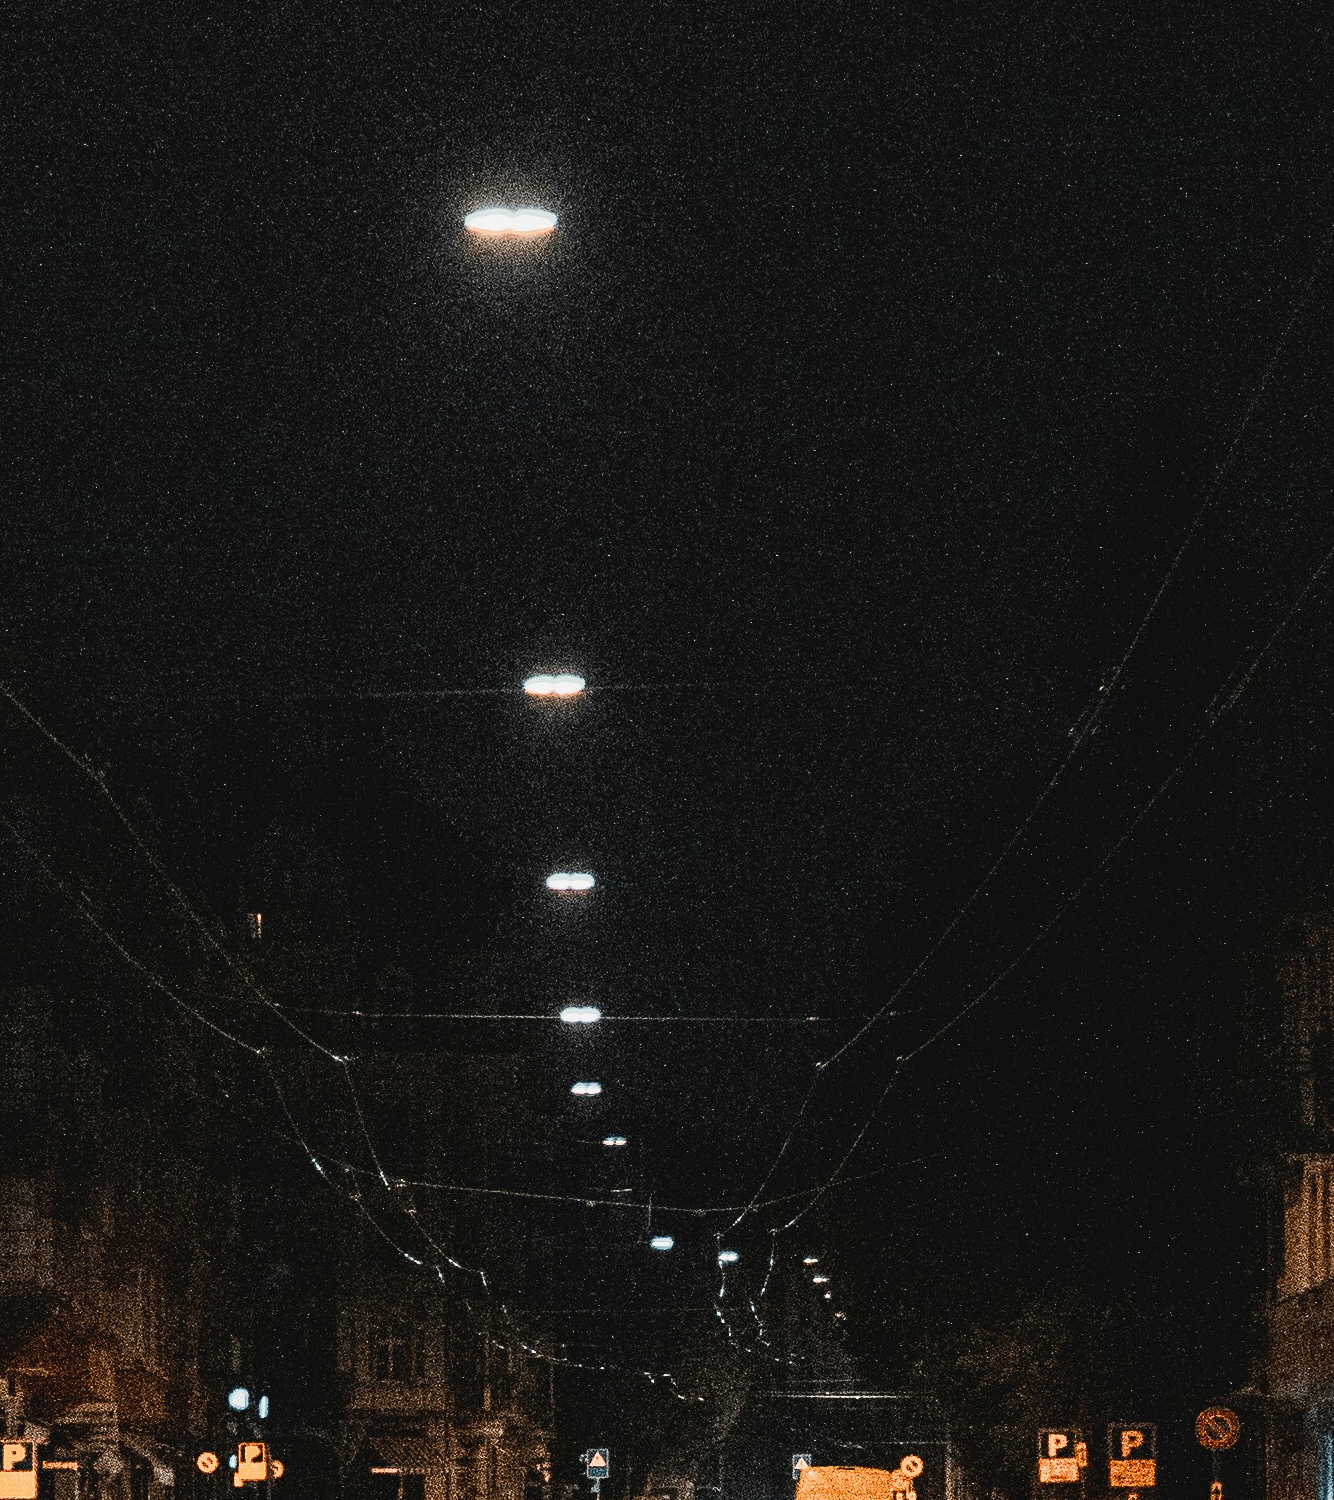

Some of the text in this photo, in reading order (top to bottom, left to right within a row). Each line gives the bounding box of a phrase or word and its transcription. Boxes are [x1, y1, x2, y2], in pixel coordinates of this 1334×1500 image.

[1047, 1433, 1069, 1457] P
[1120, 1430, 1144, 1457] P
[3, 1444, 27, 1470] P
